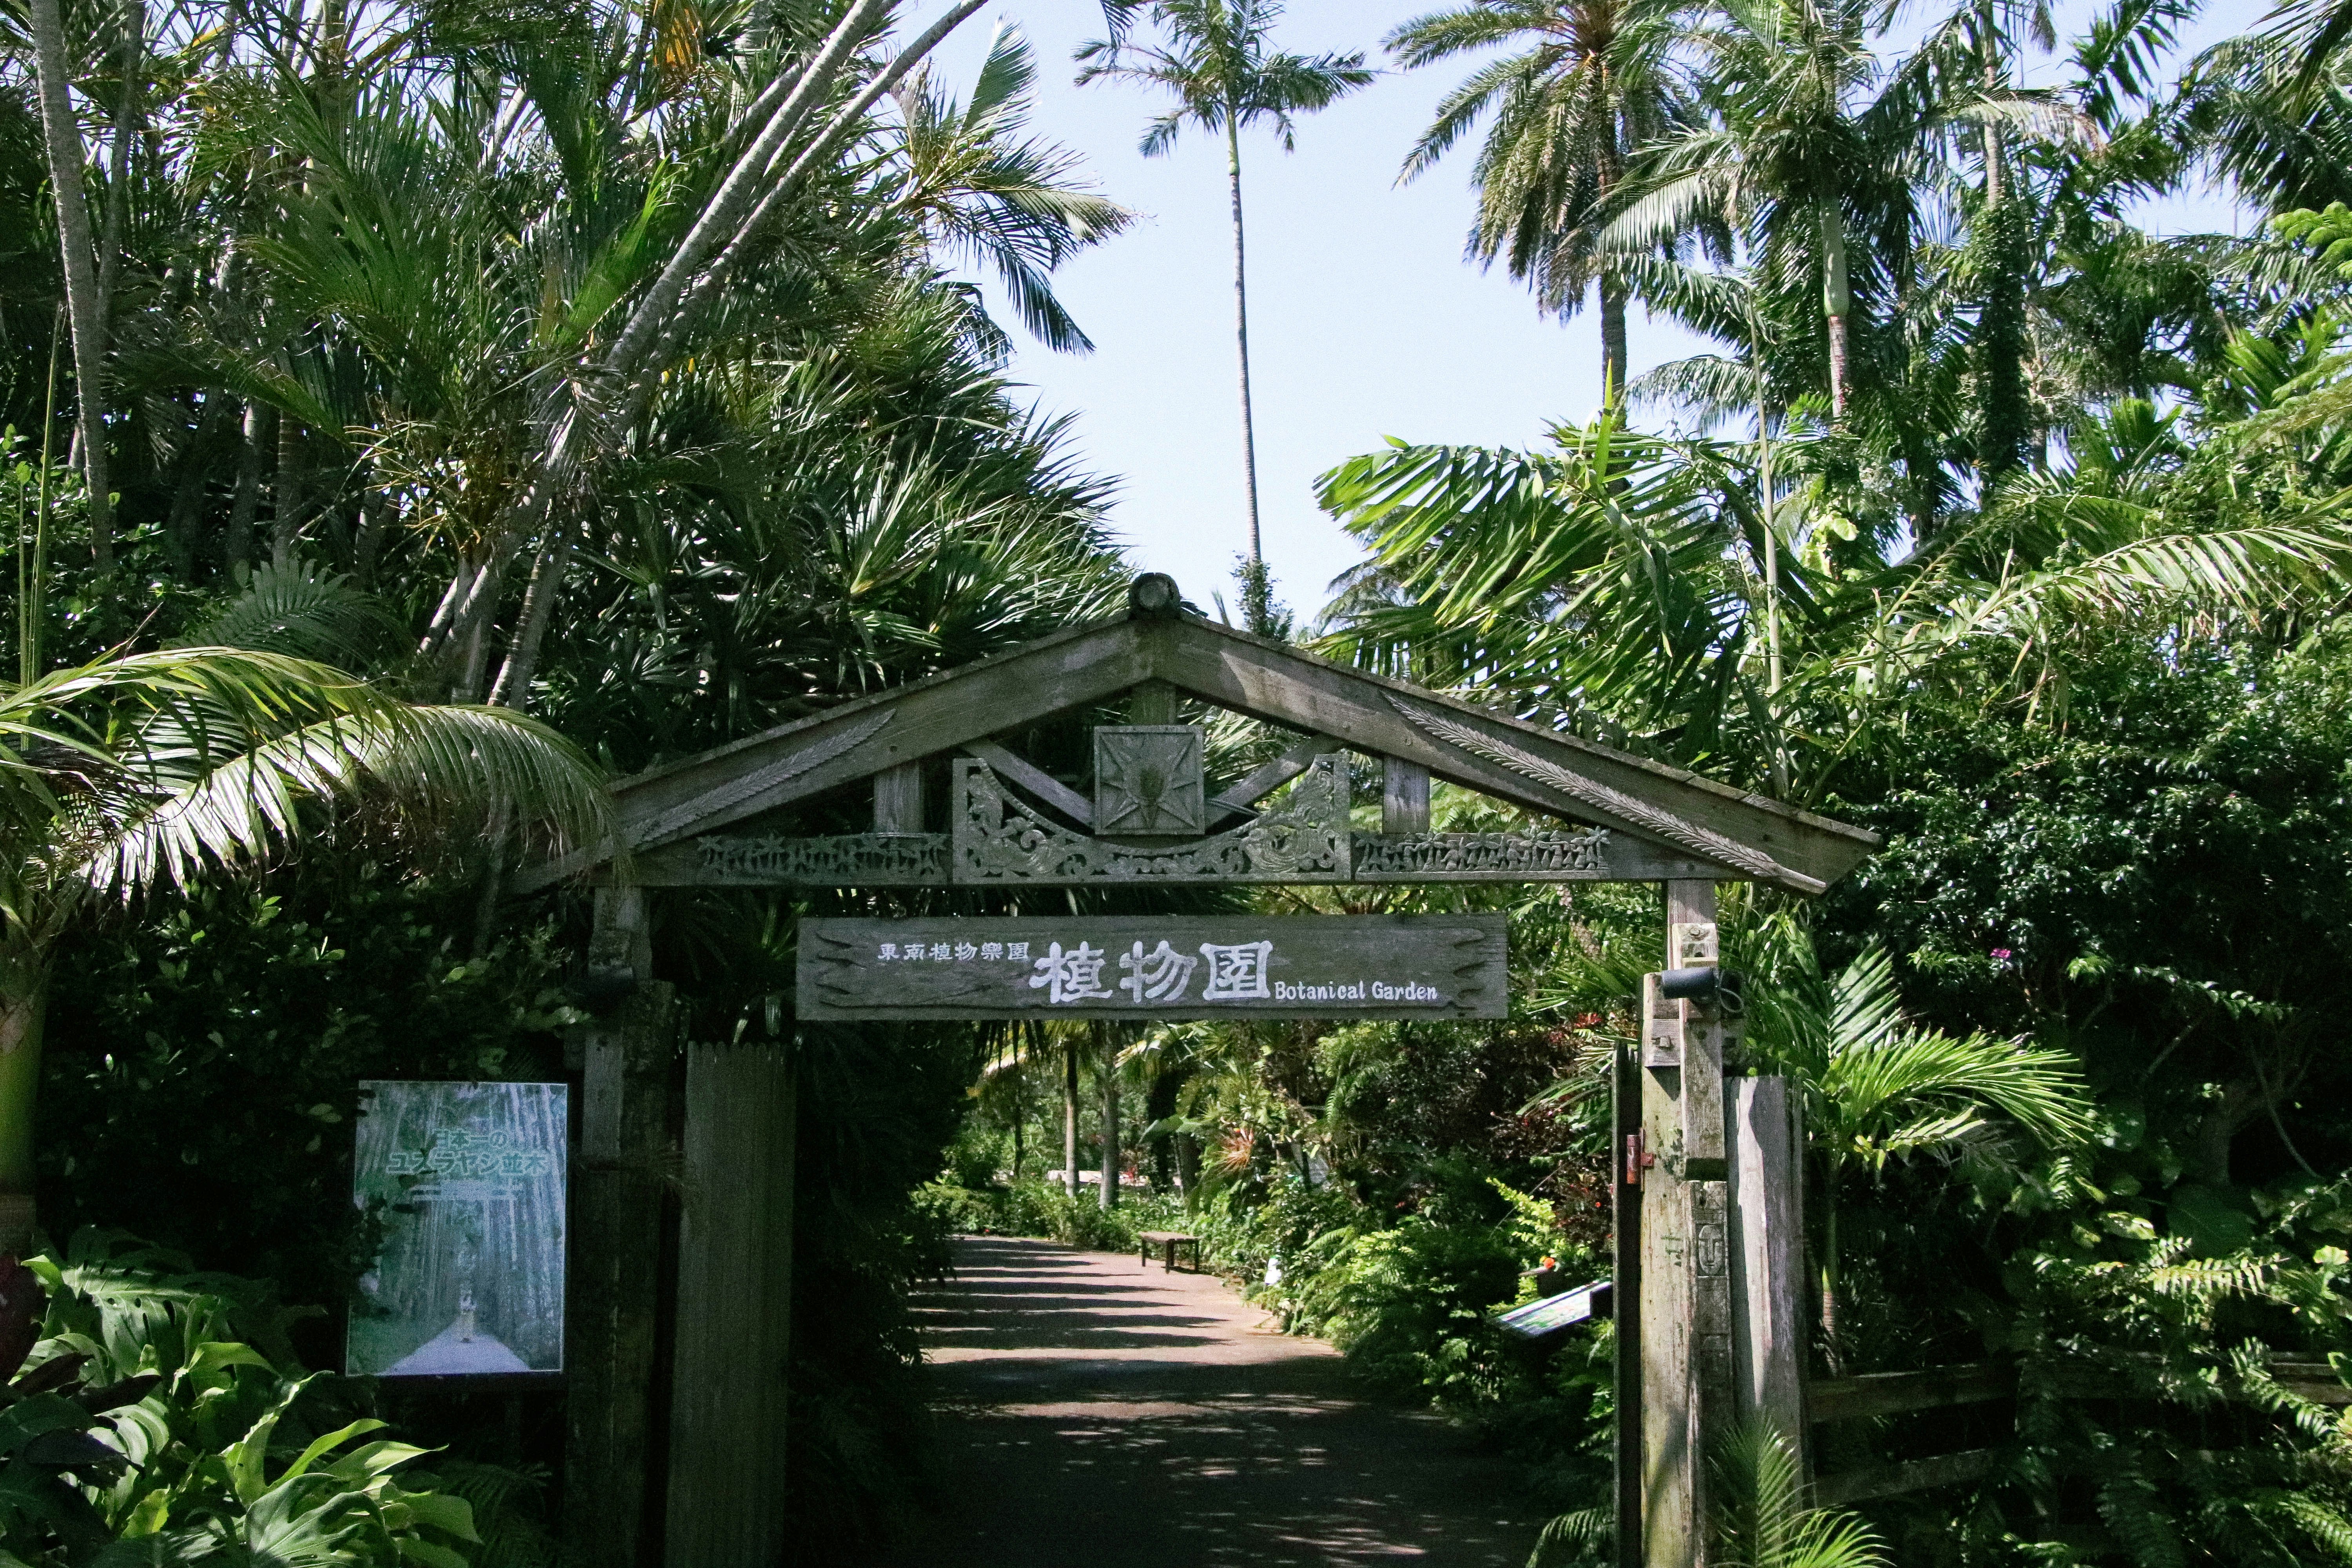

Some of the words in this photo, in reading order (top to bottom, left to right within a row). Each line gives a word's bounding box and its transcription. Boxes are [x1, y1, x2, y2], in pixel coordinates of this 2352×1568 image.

[1029, 940, 1273, 1004] 植物園
[1274, 980, 1365, 1000] Botanical
[1372, 981, 1437, 1000] Garden
